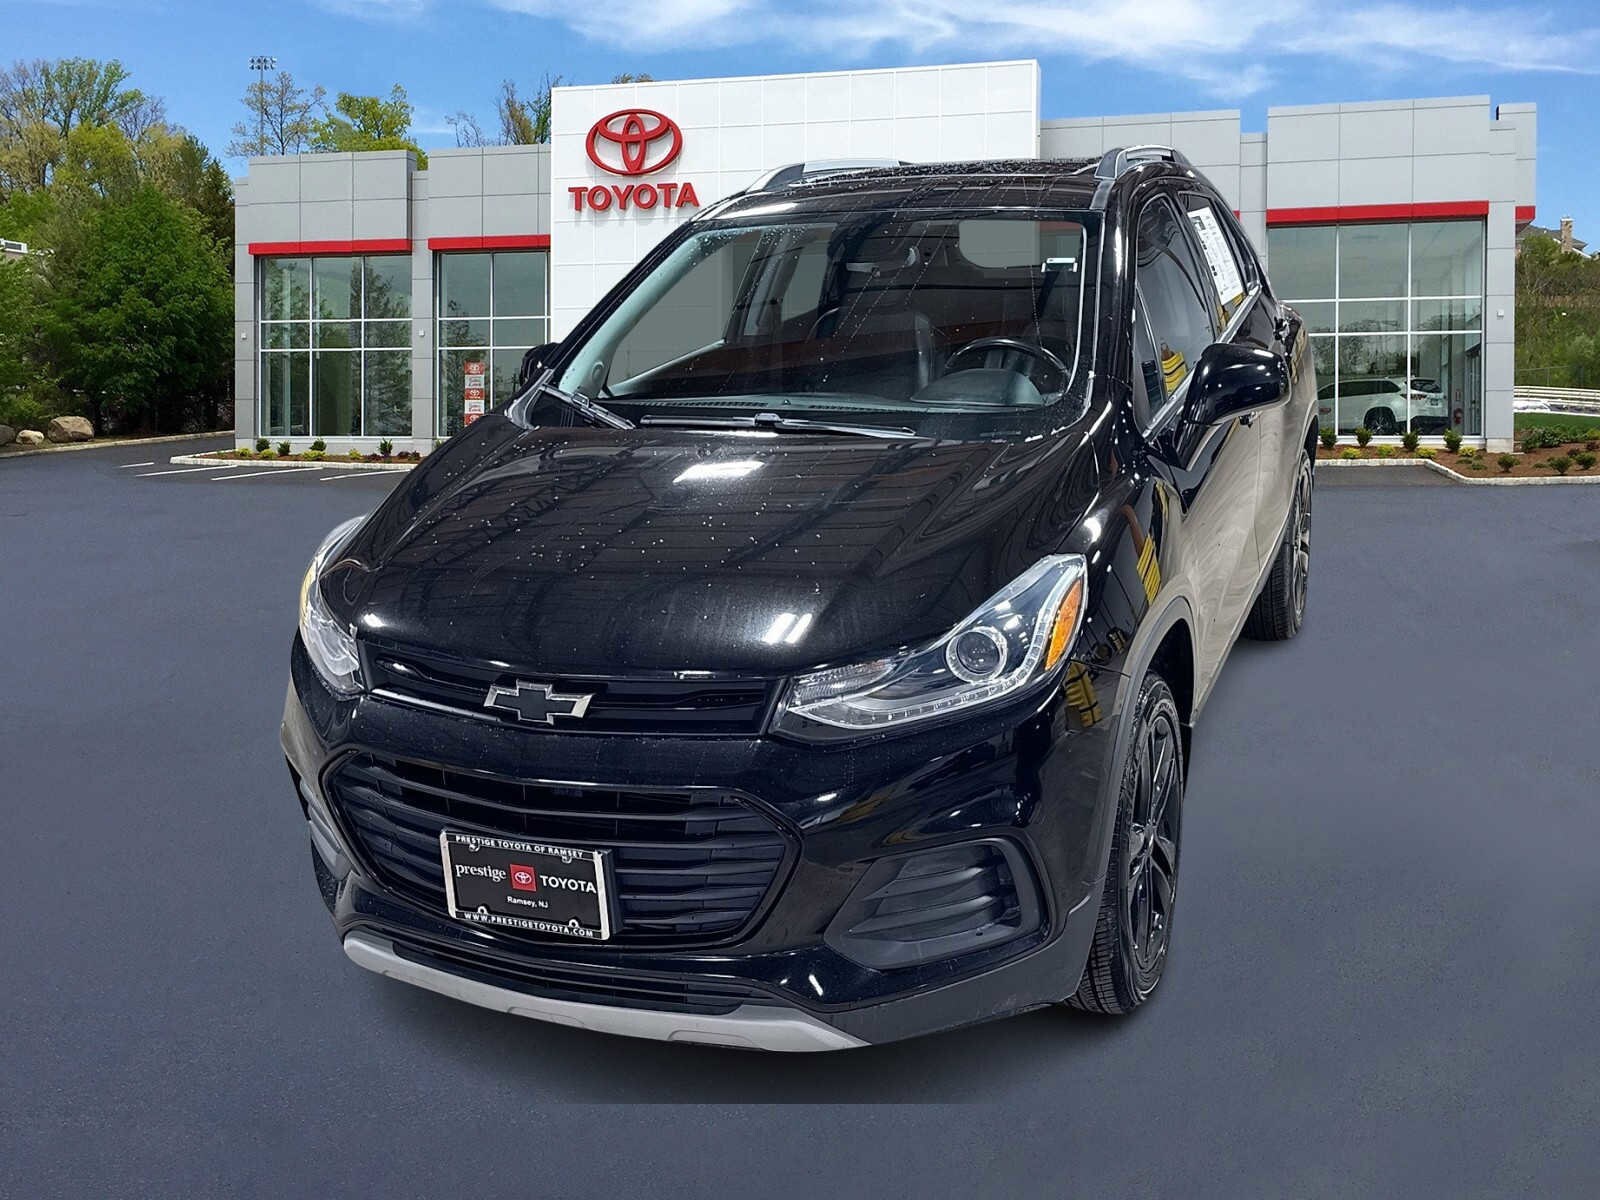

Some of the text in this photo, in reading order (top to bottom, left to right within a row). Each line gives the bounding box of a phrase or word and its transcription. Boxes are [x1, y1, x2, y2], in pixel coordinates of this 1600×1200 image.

[568, 182, 700, 212] TOYOTA
[455, 835, 583, 858] PRESTIGE TOYOTA OF RAMSEY
[455, 864, 597, 894] prestige TOYOTA
[507, 896, 549, 909] Ramsey, NJ
[464, 912, 594, 937] WWW.PRESTIGETOYOTA.COM
